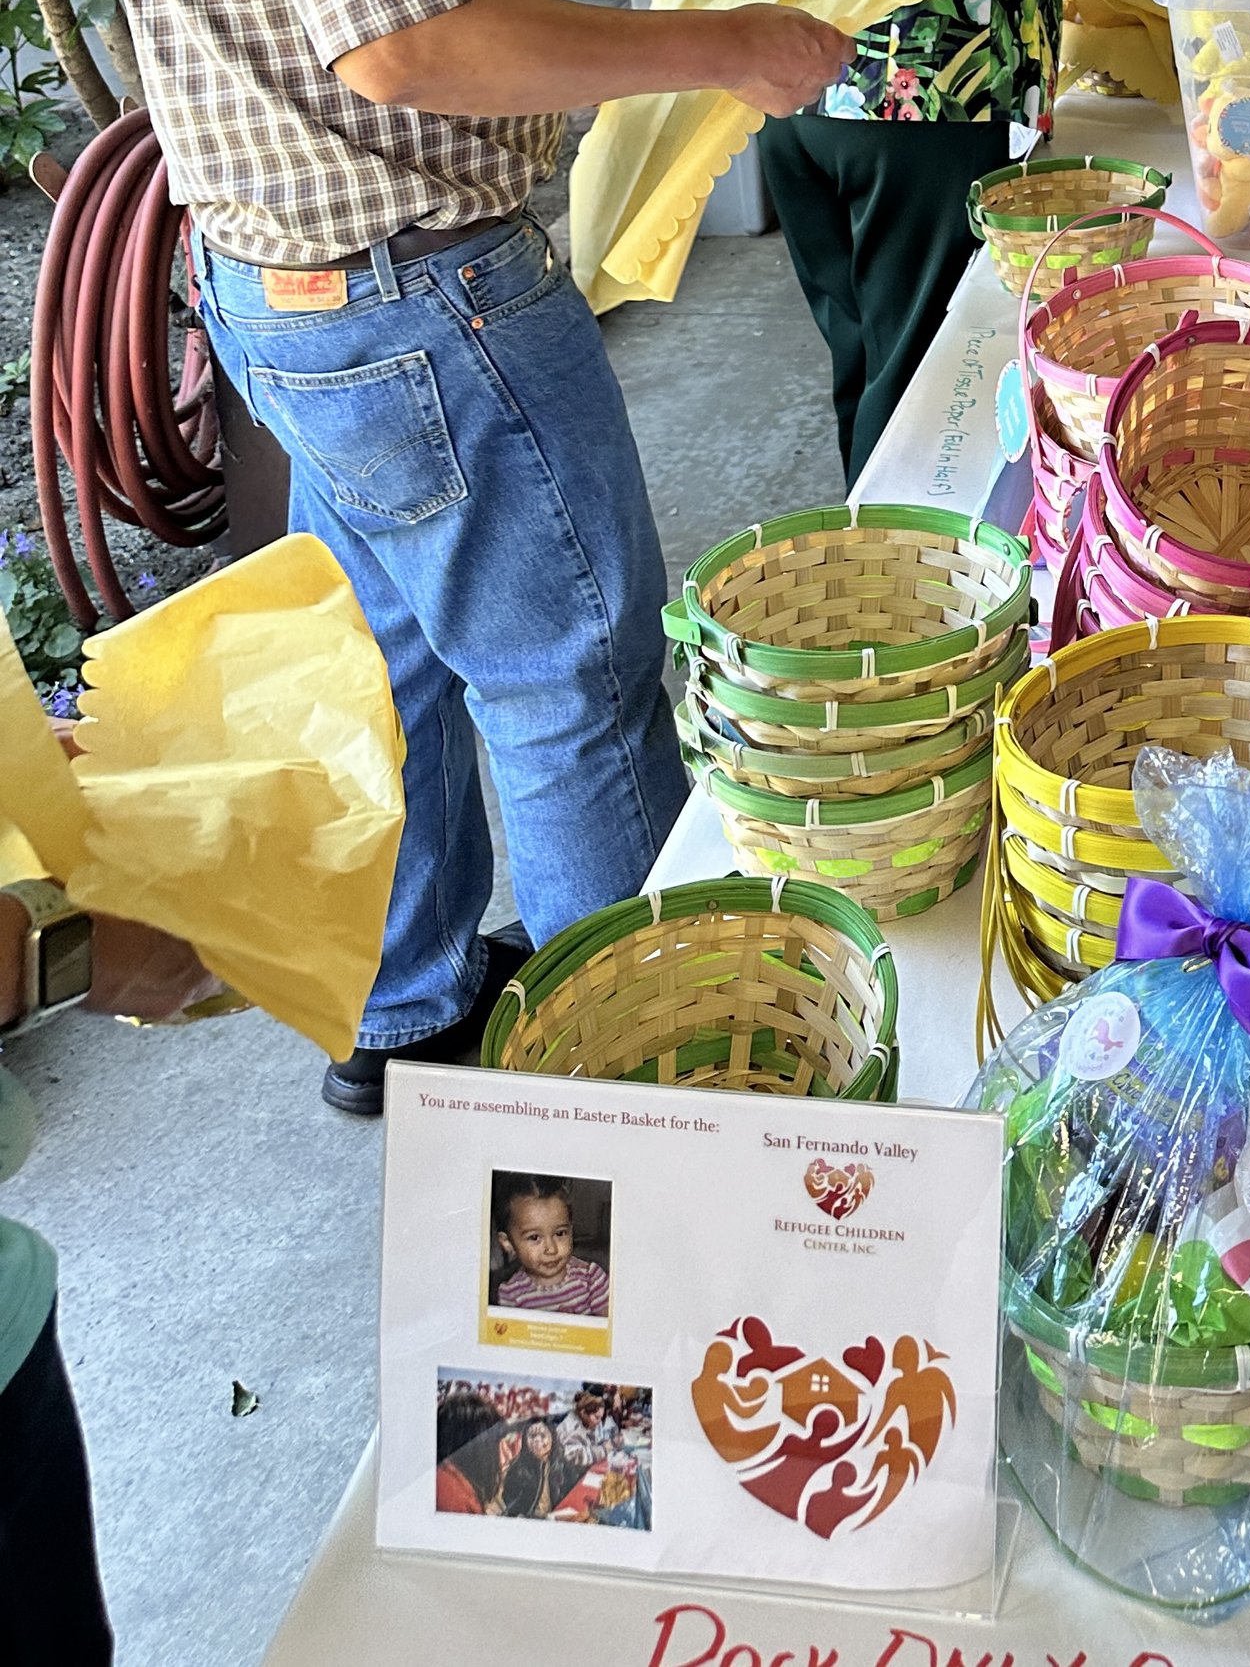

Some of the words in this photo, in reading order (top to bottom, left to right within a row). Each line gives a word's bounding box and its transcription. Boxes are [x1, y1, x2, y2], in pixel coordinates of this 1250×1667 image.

[942, 398, 977, 429] Paper
[419, 1093, 445, 1109] You
[449, 1098, 470, 1111] are
[473, 1099, 550, 1121] assembling
[552, 1106, 570, 1120] an
[573, 1107, 617, 1124] Easter
[621, 1111, 667, 1129] Basket
[670, 1115, 690, 1131] for
[693, 1117, 720, 1134] the:
[763, 1132, 791, 1149] San
[796, 1135, 869, 1155] Fernando
[873, 1141, 918, 1163] Valley
[774, 1219, 832, 1236] REFUGEE
[835, 1224, 905, 1242] CHILDREN
